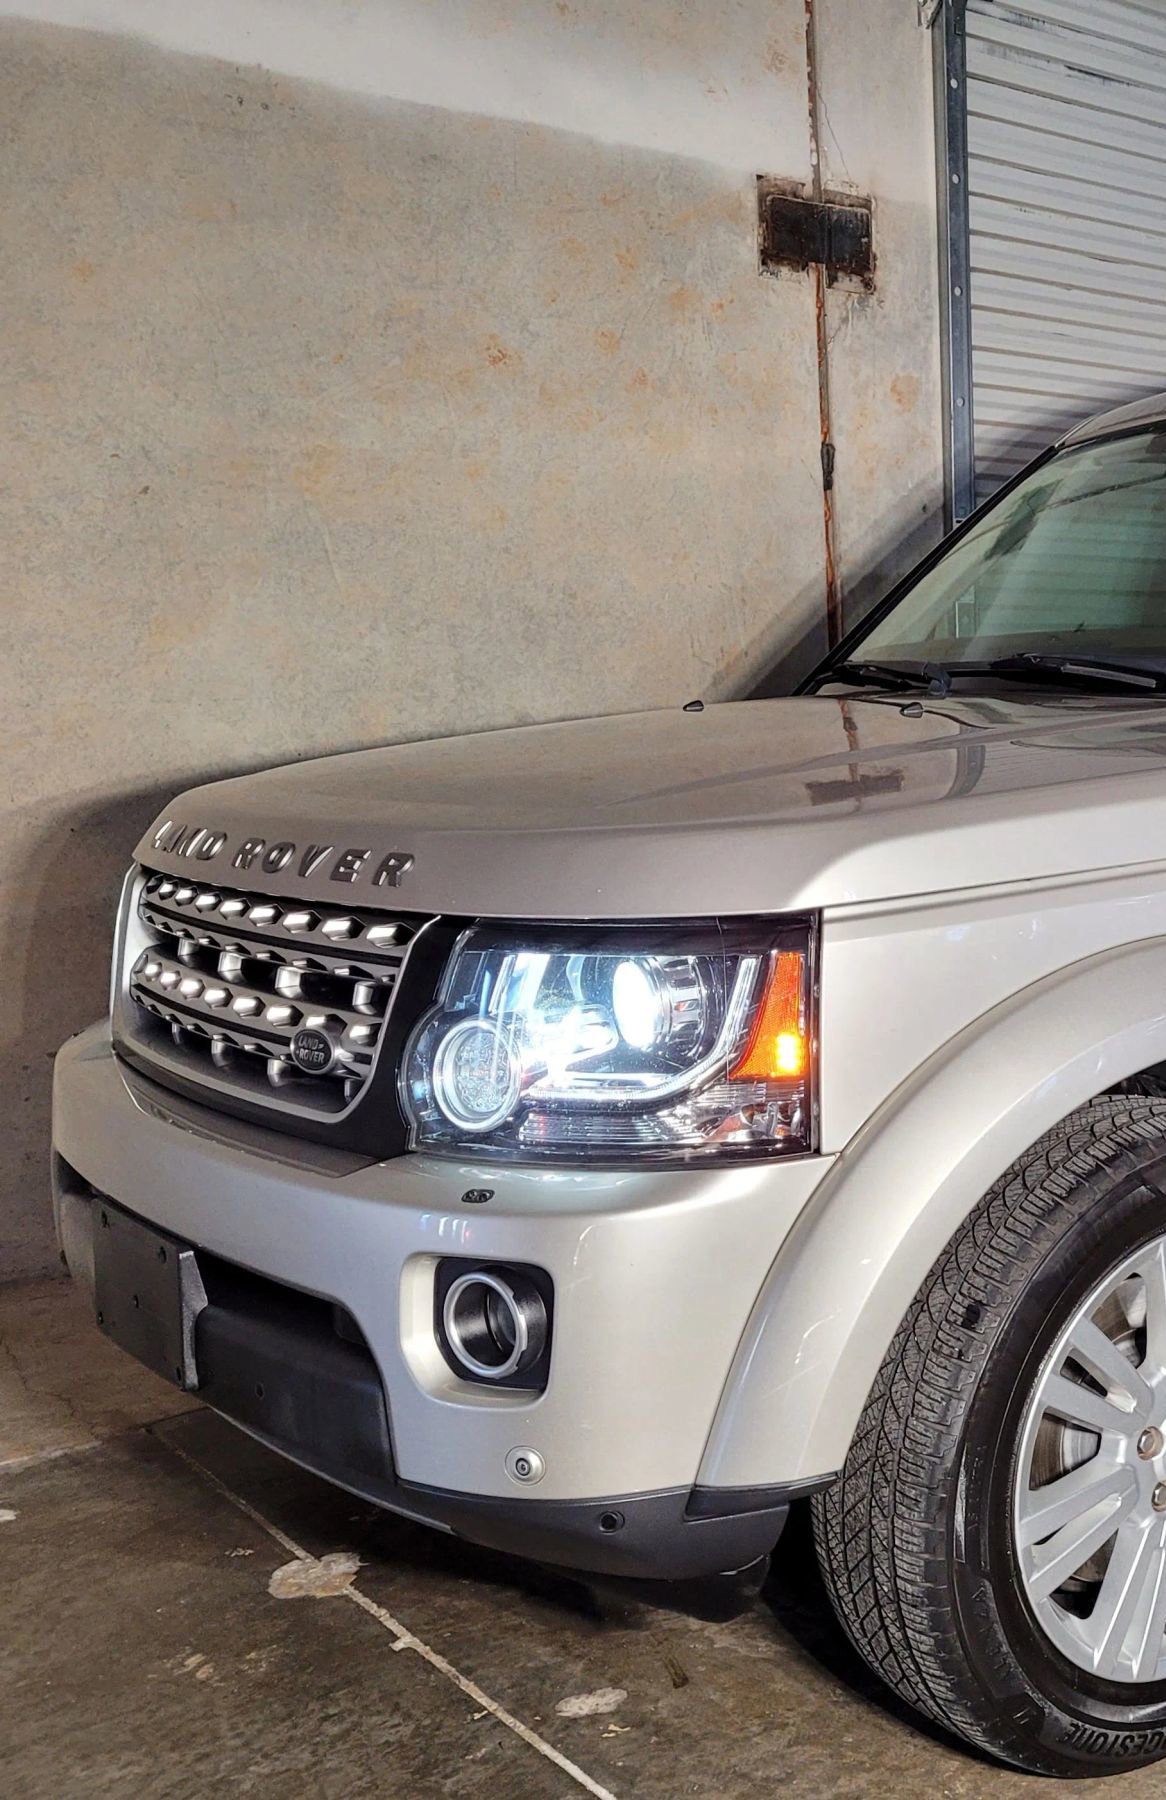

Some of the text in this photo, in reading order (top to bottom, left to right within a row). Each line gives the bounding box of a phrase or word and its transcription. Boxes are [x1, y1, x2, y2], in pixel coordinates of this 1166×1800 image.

[153, 820, 416, 888] LAND ROVER
[298, 1035, 319, 1050] LAND
[299, 1048, 325, 1064] ROVER
